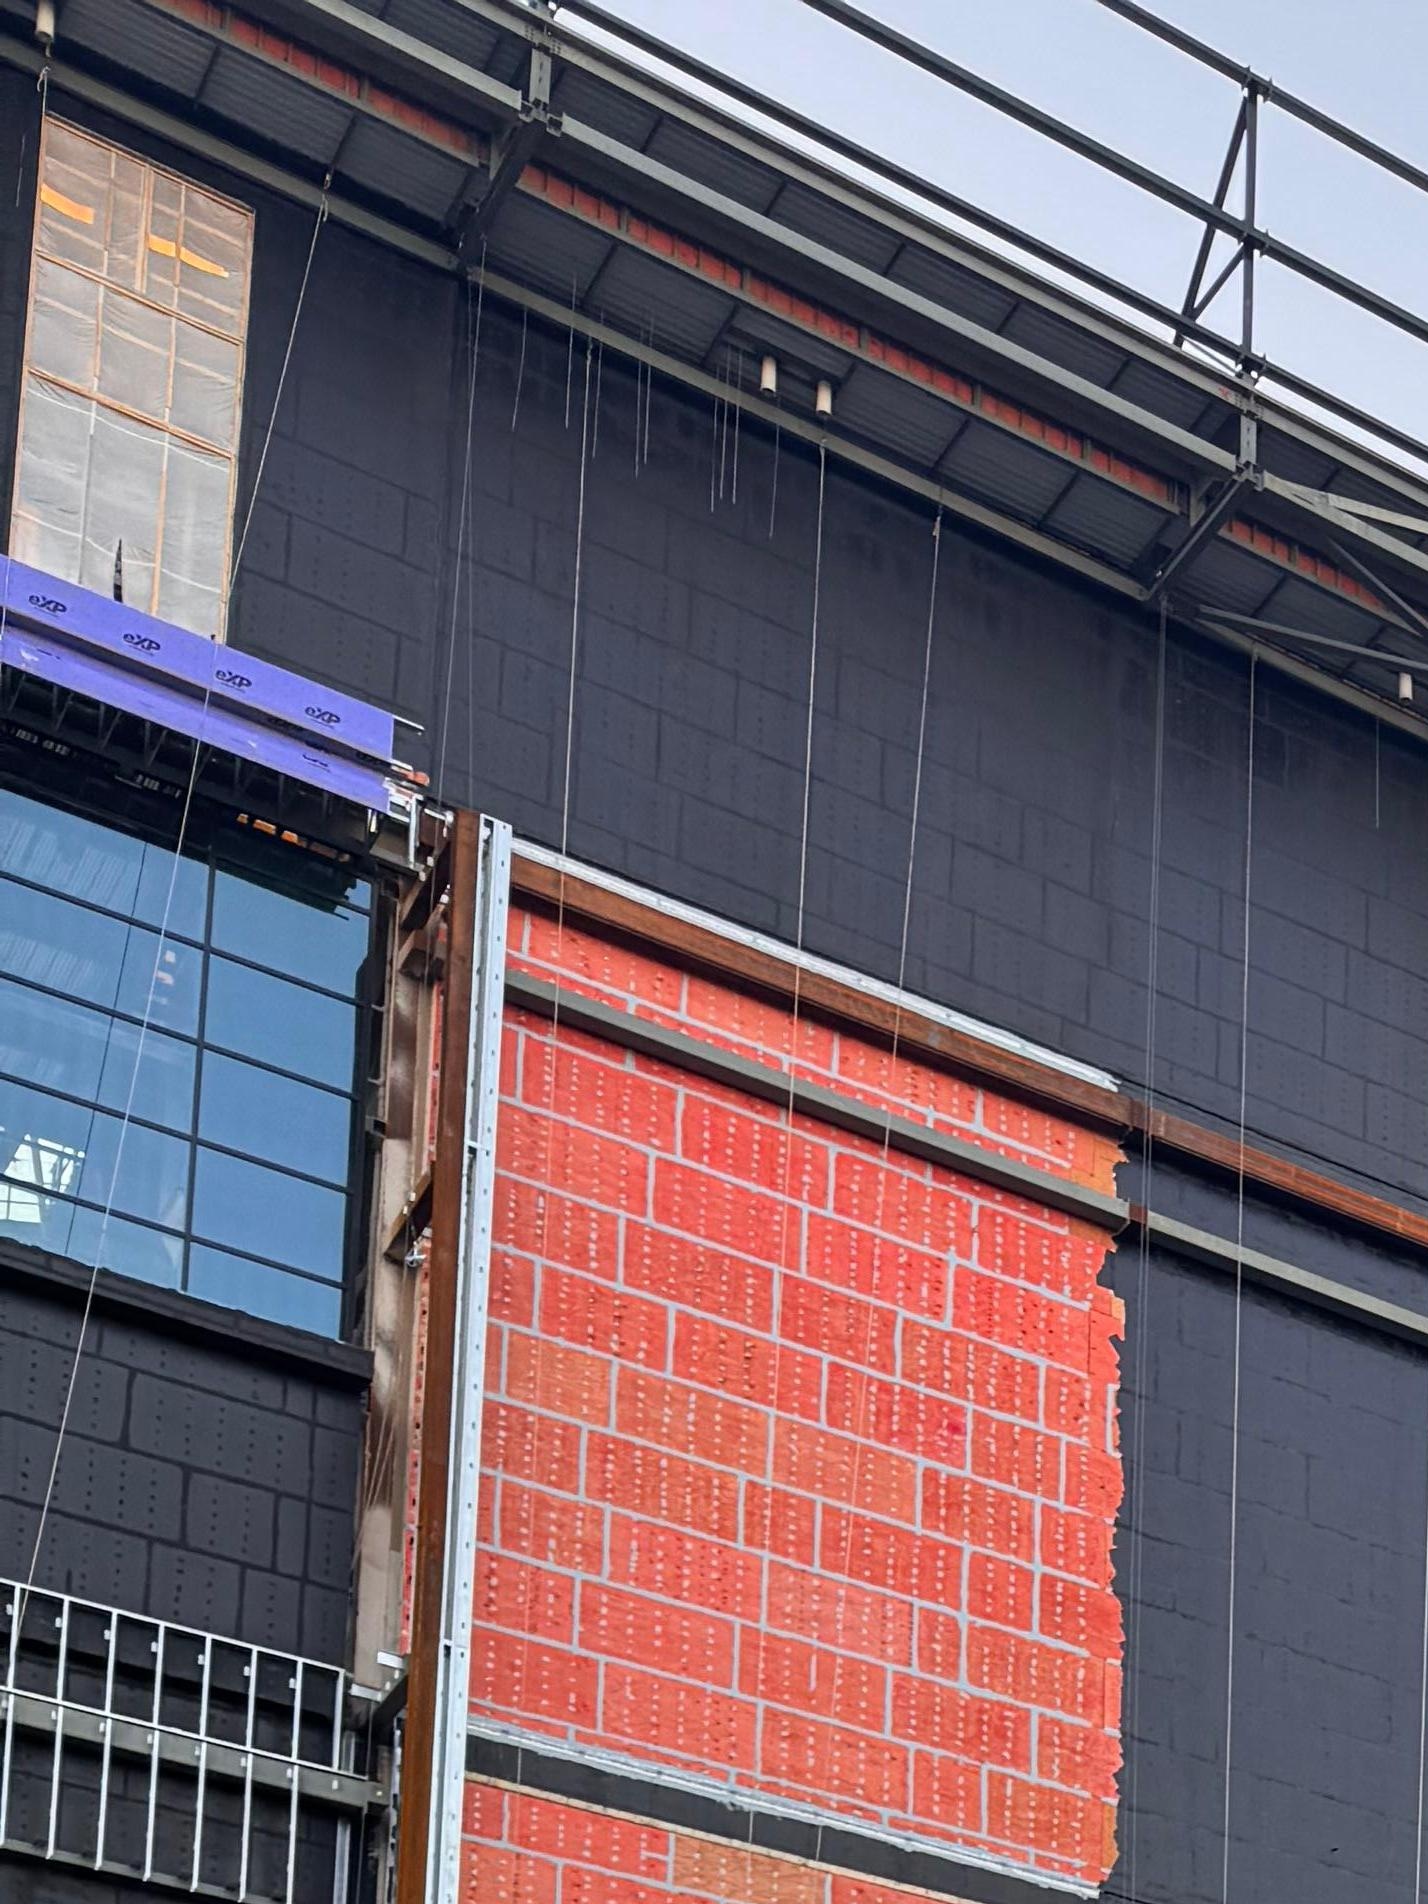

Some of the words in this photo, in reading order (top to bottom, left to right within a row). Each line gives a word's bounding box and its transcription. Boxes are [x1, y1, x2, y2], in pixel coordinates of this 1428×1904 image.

[29, 595, 67, 614] eXP
[123, 632, 161, 652] eXP
[215, 669, 253, 689] eXP
[305, 706, 341, 725] eXP
